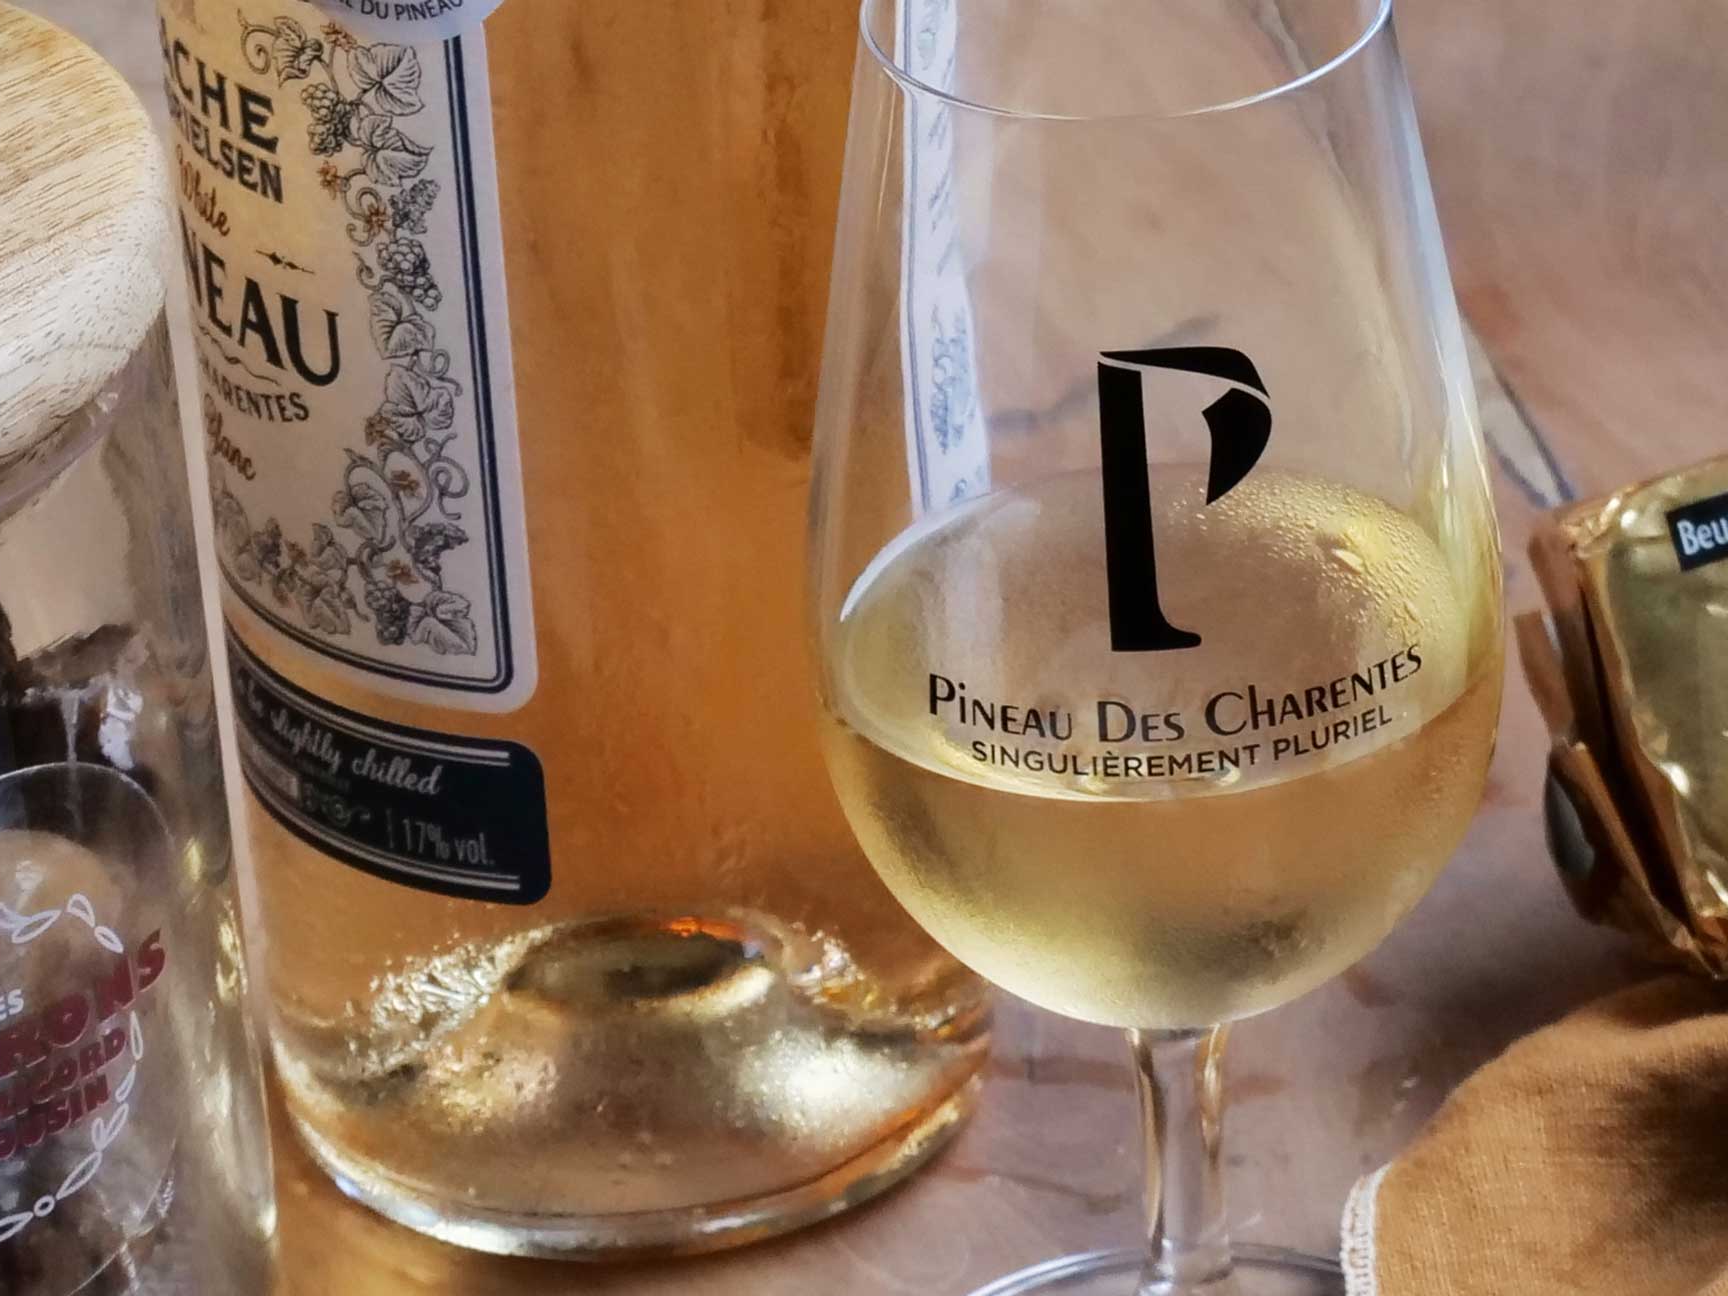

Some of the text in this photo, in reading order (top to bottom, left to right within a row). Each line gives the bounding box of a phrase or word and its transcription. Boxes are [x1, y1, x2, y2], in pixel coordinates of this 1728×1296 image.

[971, 703, 1393, 778] SINGULIÈREMENT PLURIEL
[351, 749, 444, 796] chilled
[403, 817, 450, 860] 17%
